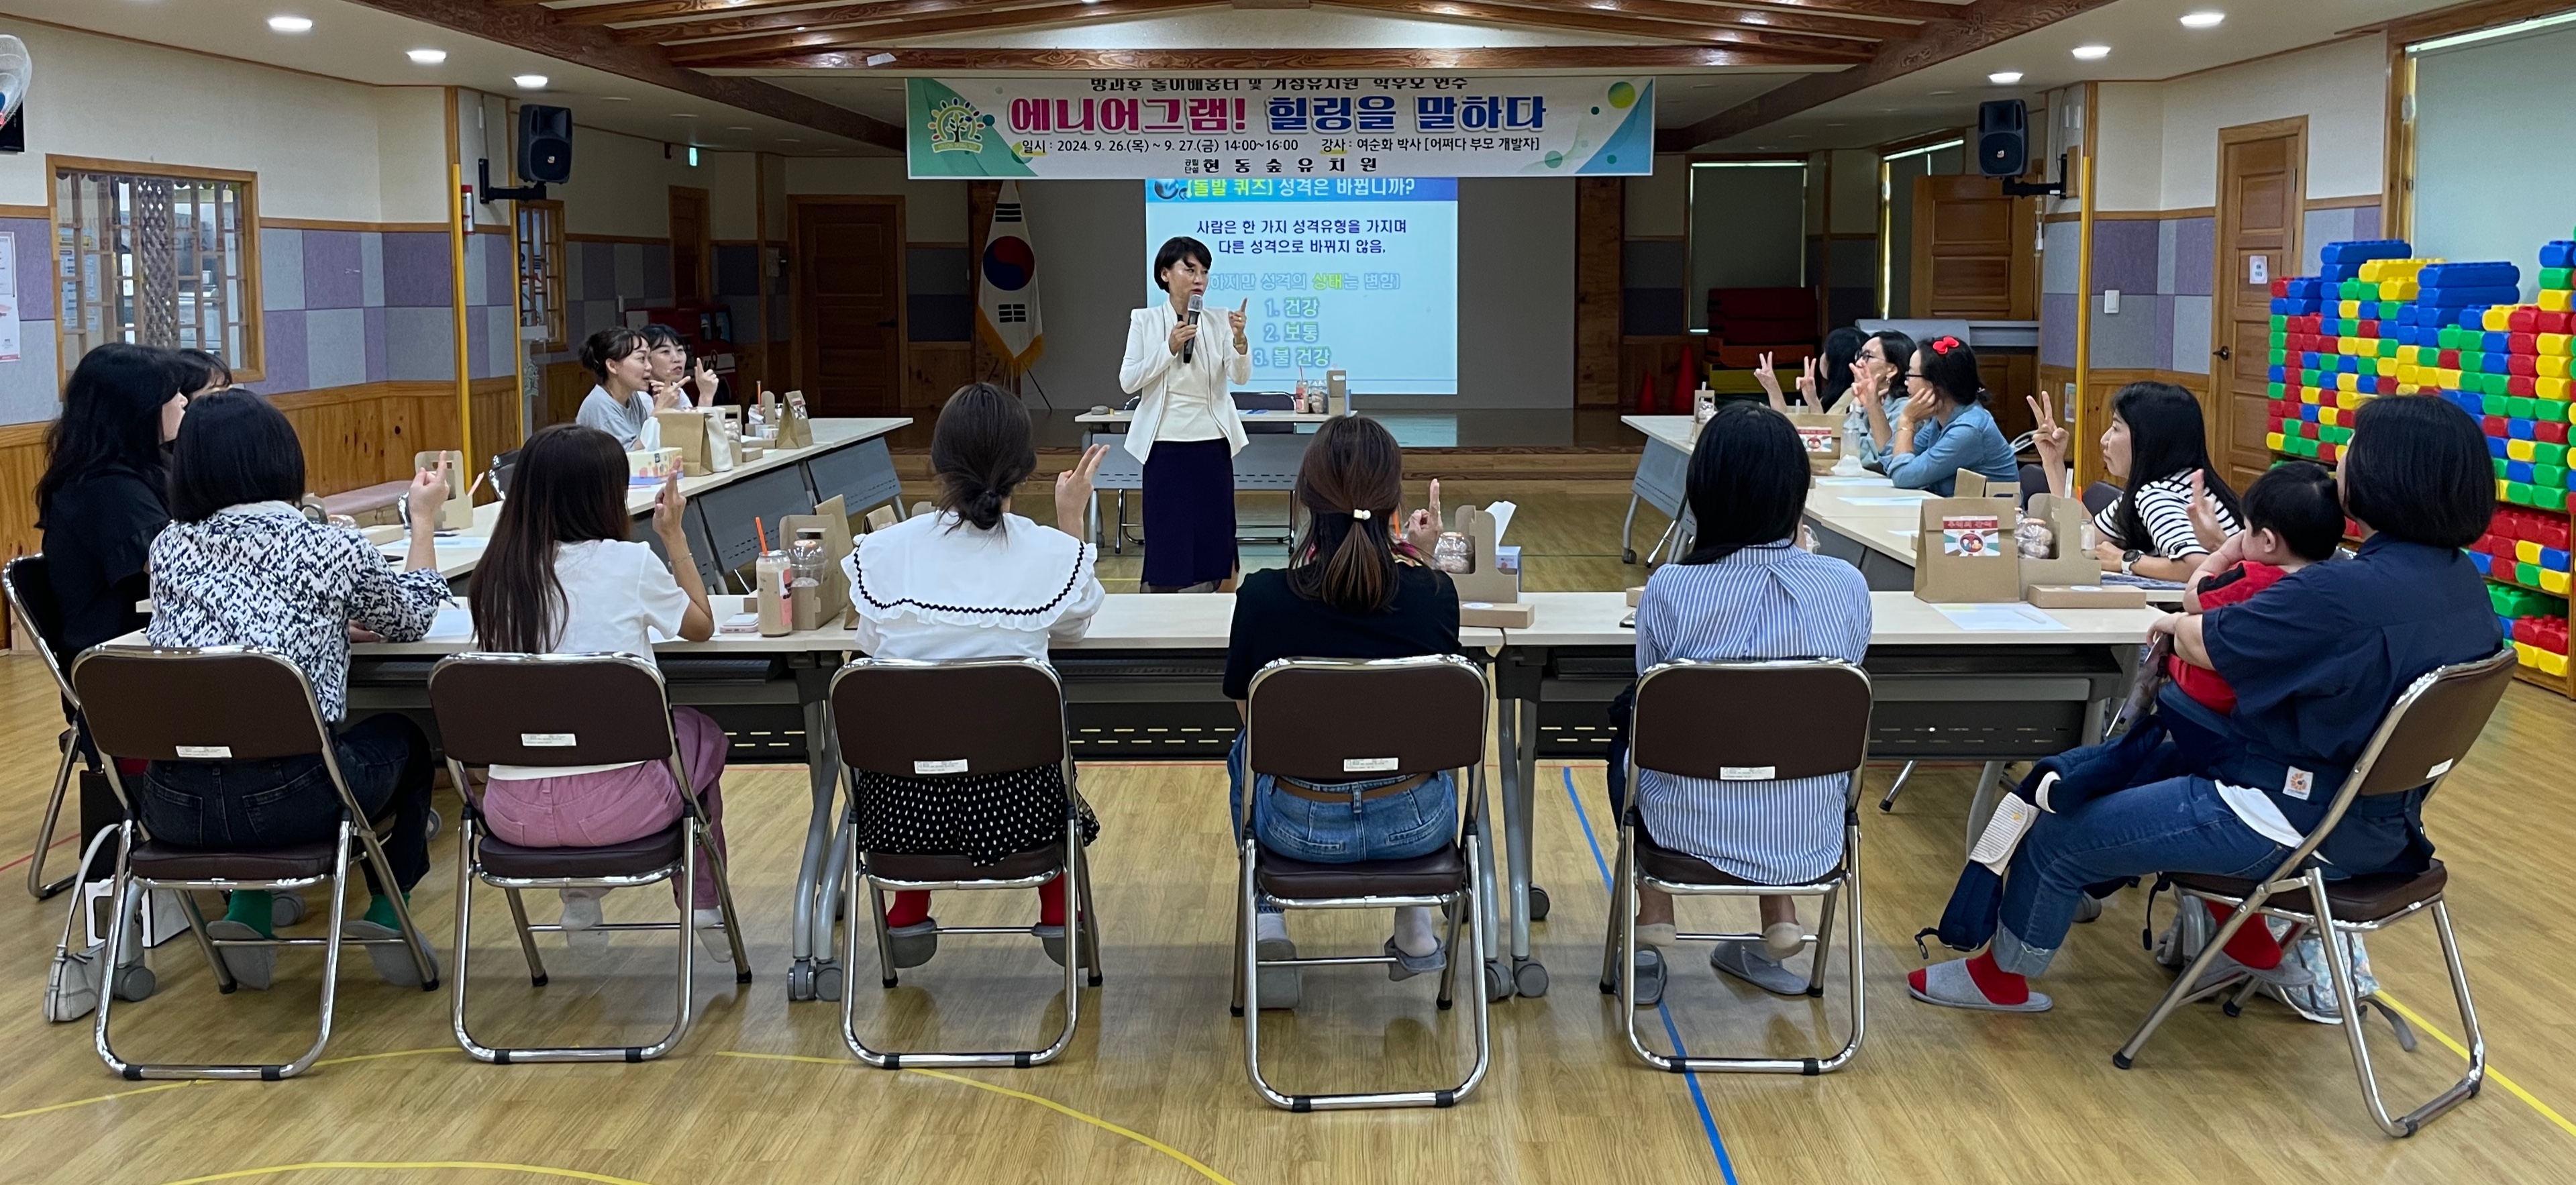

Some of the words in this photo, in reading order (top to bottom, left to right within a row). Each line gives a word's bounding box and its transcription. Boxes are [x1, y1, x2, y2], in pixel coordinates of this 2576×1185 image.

[1011, 98, 1245, 131] 에니어그램!
[1269, 96, 1396, 130] 힐링을
[1418, 96, 1547, 129] 말하다
[1023, 140, 1045, 154] 일시
[1058, 140, 1090, 152] 2024.
[1094, 140, 1105, 151] 9.
[1109, 140, 1149, 153] 26.(목)
[1165, 140, 1175, 151] 9.
[1179, 140, 1219, 153] 27.(금)
[1225, 140, 1298, 151] 14:00~16:00
[1322, 138, 1346, 152] 강사
[1357, 138, 1394, 152] 여순화
[1398, 138, 1421, 151] 박사
[1425, 138, 1467, 151] [어쩌다
[1470, 138, 1494, 151] 부모
[1499, 138, 1539, 151] 개발자]
[1279, 178, 1329, 197] 성격은
[1337, 178, 1415, 196] 바뀝니까?
[1196, 220, 1237, 234] 사람은
[1243, 220, 1255, 234] 한
[1261, 220, 1286, 234] 가지
[1292, 219, 1360, 234] 성격유형을
[1366, 219, 1406, 233] 가지며
[1219, 240, 1245, 254] 다른
[1250, 240, 1304, 254] 성격으로
[1310, 240, 1349, 253] 바뀌지
[1207, 274, 1256, 290] 하지만
[1261, 273, 1306, 290] 성격의
[1312, 273, 1359, 290] 상태는
[1266, 299, 1279, 317] 1.
[1285, 297, 1319, 317] 건강
[1264, 324, 1279, 342] 2.
[1284, 322, 1318, 342] 보통
[1253, 349, 1268, 366] 3.
[1274, 348, 1290, 367] 불
[1296, 347, 1331, 367] 건강
